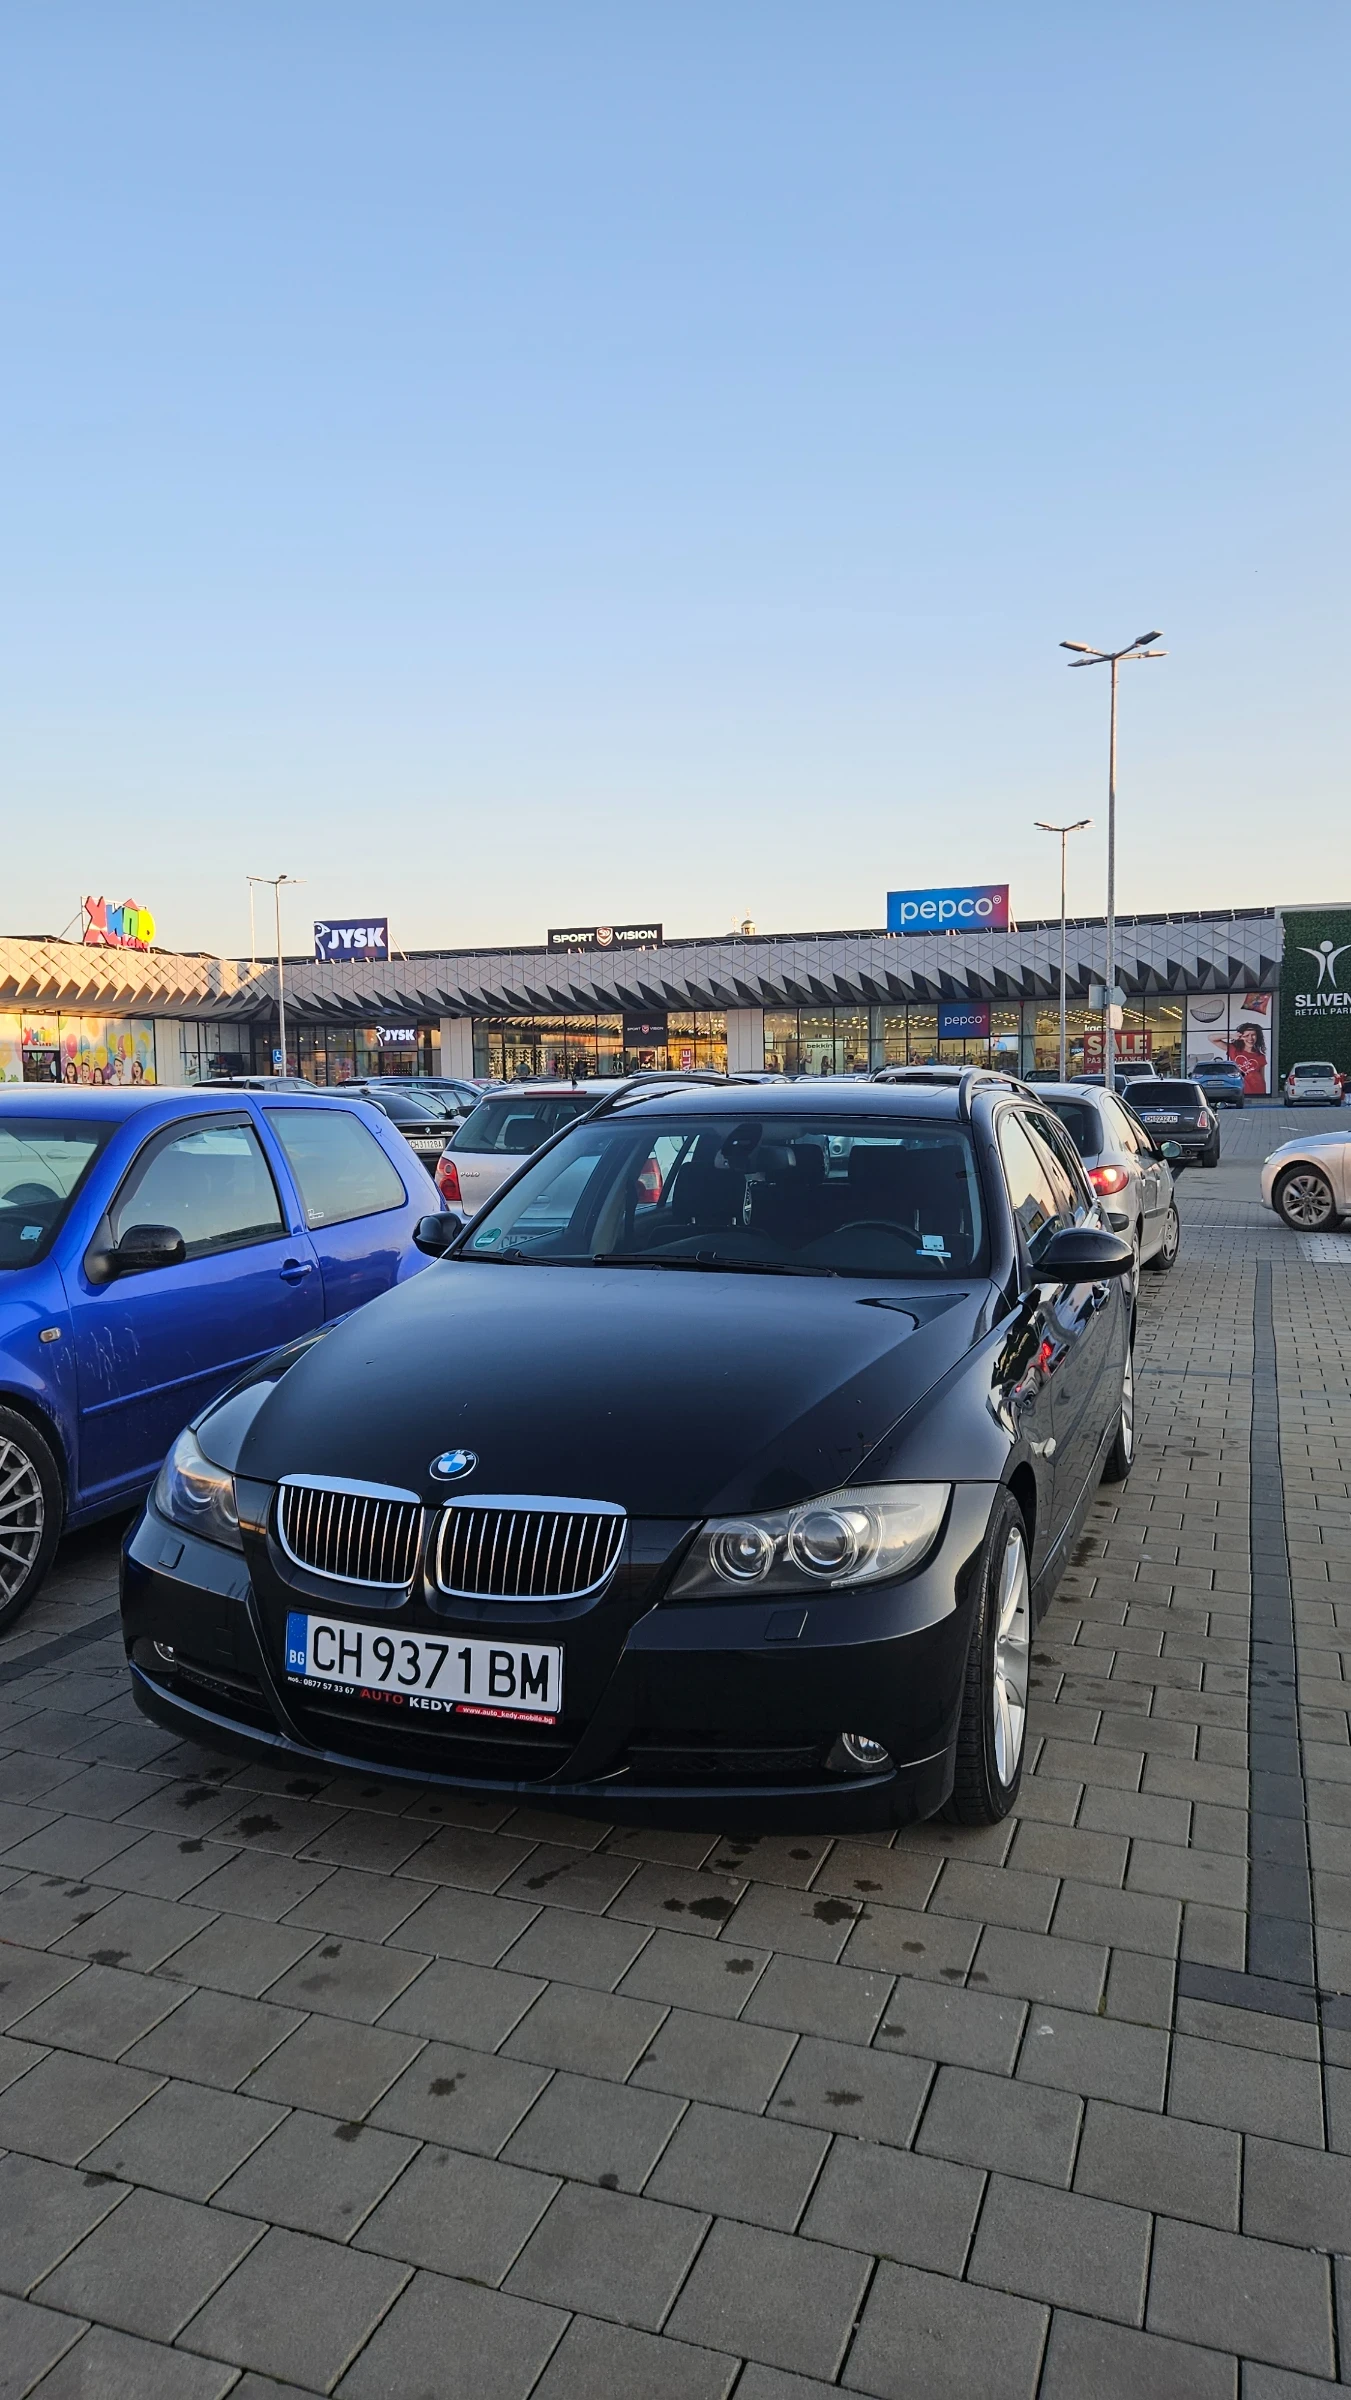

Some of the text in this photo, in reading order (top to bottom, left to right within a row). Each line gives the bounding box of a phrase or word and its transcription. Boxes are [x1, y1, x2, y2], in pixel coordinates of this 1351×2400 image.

[901, 898, 993, 925] pepco
[328, 927, 386, 950] JYSK
[552, 930, 658, 944] SPORT VISION
[1295, 1007, 1351, 1016] RETAIL PAR
[944, 1016, 982, 1026] pepco
[384, 1029, 416, 1041] JYSK
[289, 1649, 305, 1666] BG
[313, 1625, 549, 1703] CH 9371 BM
[303, 1678, 321, 1688] 0877
[323, 1682, 332, 1690] 57
[334, 1684, 343, 1693] 33
[345, 1686, 355, 1695] 67
[361, 1688, 553, 1725] AUTO KEDY www.auto_kedy.mobile.bg
